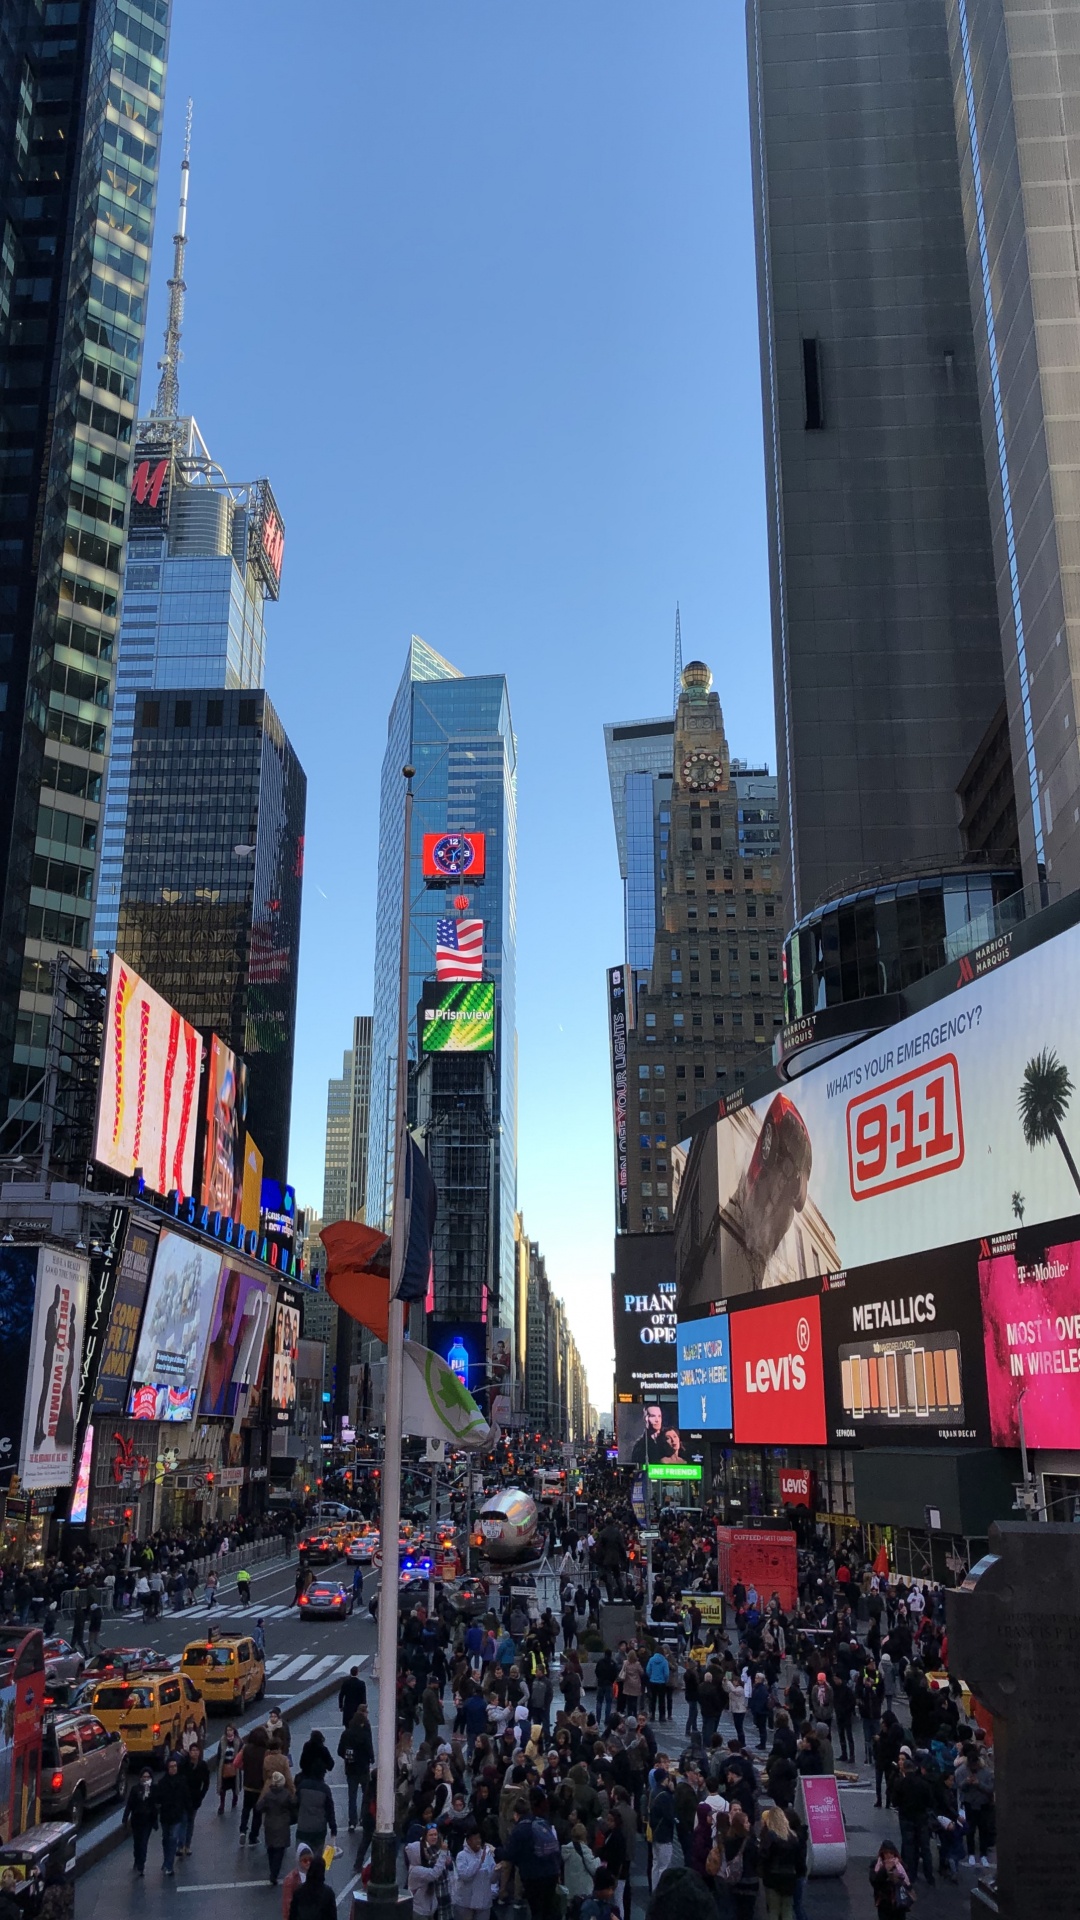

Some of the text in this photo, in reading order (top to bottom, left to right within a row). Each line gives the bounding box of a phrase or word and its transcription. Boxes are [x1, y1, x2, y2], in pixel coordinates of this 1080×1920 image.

[264, 511, 284, 579] H&M
[975, 931, 1013, 961] MARRIOTT
[976, 947, 1010, 974] MARQUIS
[435, 1009, 491, 1020] Prismview
[783, 1015, 817, 1038] MARRIOTT
[613, 1012, 627, 1069] LIGHTS
[783, 1029, 813, 1050] MARQUIS
[826, 1004, 983, 1099] WHAT'S YOUR EMERGENCY?
[616, 1071, 627, 1119] YOUR
[18, 1221, 49, 1229] LAMAR
[225, 1216, 305, 1280] BROADWAY
[990, 1231, 1018, 1245] MARRIOTT
[992, 1242, 1017, 1254] MARQUIS
[829, 1272, 847, 1281] MARRIOTT
[829, 1279, 846, 1289] MARQUIS
[56, 1288, 70, 1353] PRETTY
[112, 1302, 141, 1330] COME
[651, 1314, 665, 1325] OF
[852, 1292, 936, 1332] METALLICS
[1006, 1319, 1042, 1346] MOST
[703, 1339, 723, 1359] YOUR
[101, 1350, 132, 1377] AWAY
[708, 1365, 728, 1384] HERE
[1010, 1353, 1024, 1377] IN
[48, 1365, 63, 1437] WOMAN
[836, 1429, 856, 1438] SEPHORA
[938, 1430, 977, 1439] URBAN DECAY
[666, 1468, 698, 1476] FRIENDS
